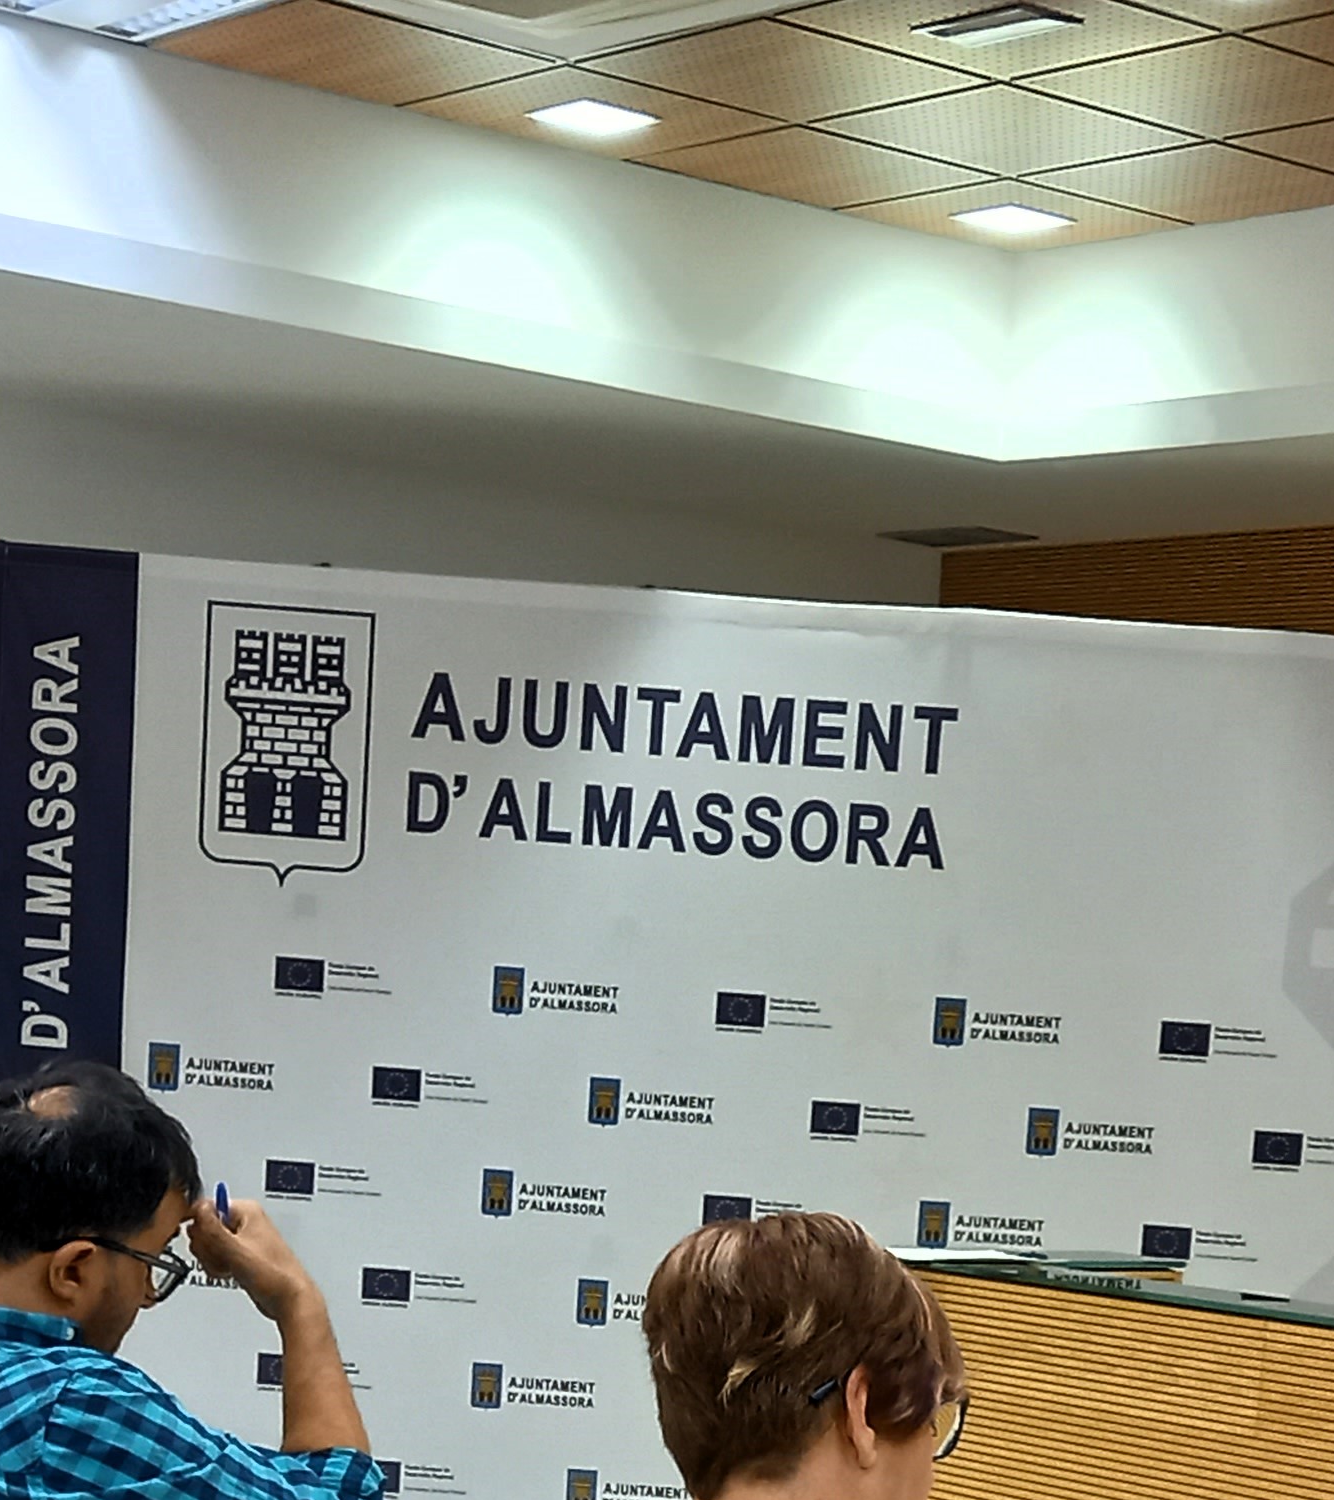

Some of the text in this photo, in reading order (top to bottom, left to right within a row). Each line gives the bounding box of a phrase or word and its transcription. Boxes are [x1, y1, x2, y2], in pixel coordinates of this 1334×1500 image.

[411, 672, 959, 776] AJUNTAMENT
[406, 771, 945, 871] D'ALMASSORA
[20, 635, 81, 1050] D'ALMASSORA
[531, 982, 618, 998] AJUNTAMENT
[530, 997, 616, 1013] D'ALMASSORA
[973, 1013, 1061, 1028] AJUNTAMENT
[971, 1028, 1059, 1043] D'ALMASSORA
[186, 1058, 274, 1075] AJUNTAMENT
[186, 1074, 272, 1090] D'ALMASSORA
[627, 1092, 714, 1109] AJUNTAMENT
[626, 1108, 712, 1124] D'ALMASSORA
[1065, 1122, 1154, 1138] AJUNTAMENT
[1064, 1138, 1152, 1154] D'ALMASSORA
[520, 1184, 606, 1201] AJUNTAMENT
[519, 1199, 604, 1216] D'ALMASSORA
[956, 1216, 1044, 1231] AJUNTAMENT
[954, 1231, 1041, 1246] D'ALMASSORA
[509, 1377, 595, 1393] AJUNTAMENT
[508, 1392, 593, 1407] D'ALMASSORA
